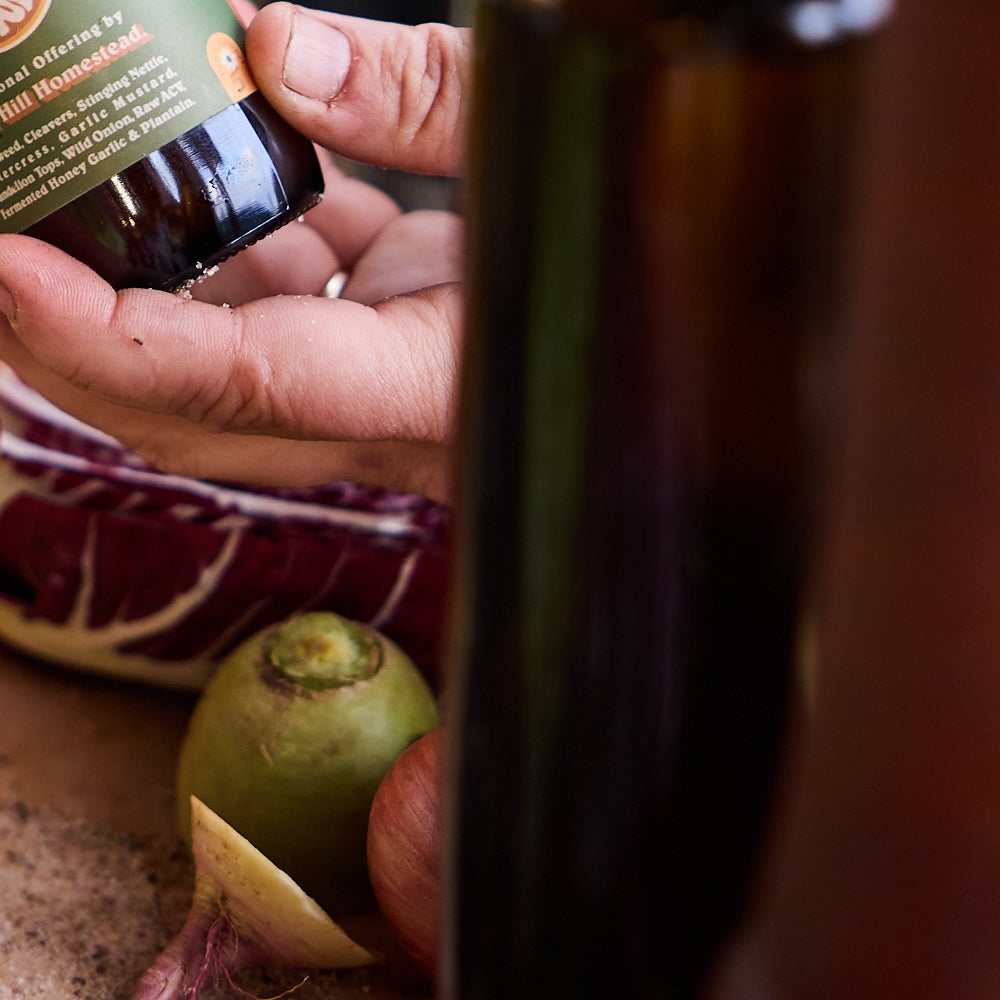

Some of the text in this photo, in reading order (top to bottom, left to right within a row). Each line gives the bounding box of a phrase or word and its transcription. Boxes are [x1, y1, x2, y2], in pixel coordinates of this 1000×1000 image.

[31, 23, 155, 103] Homestead.
[32, 22, 103, 70] Offering
[102, 10, 124, 28] by
[23, 109, 78, 144] Cleavers,
[76, 75, 131, 112] Stinging
[127, 55, 169, 81] Nettle,
[33, 157, 66, 178] Tops,
[61, 136, 94, 160] Wild
[131, 96, 161, 119] Raw
[58, 108, 109, 143] Garlic
[0, 183, 49, 220] Fermented
[47, 160, 87, 191] Honey
[87, 137, 127, 166] Garlic
[127, 128, 141, 142] &
